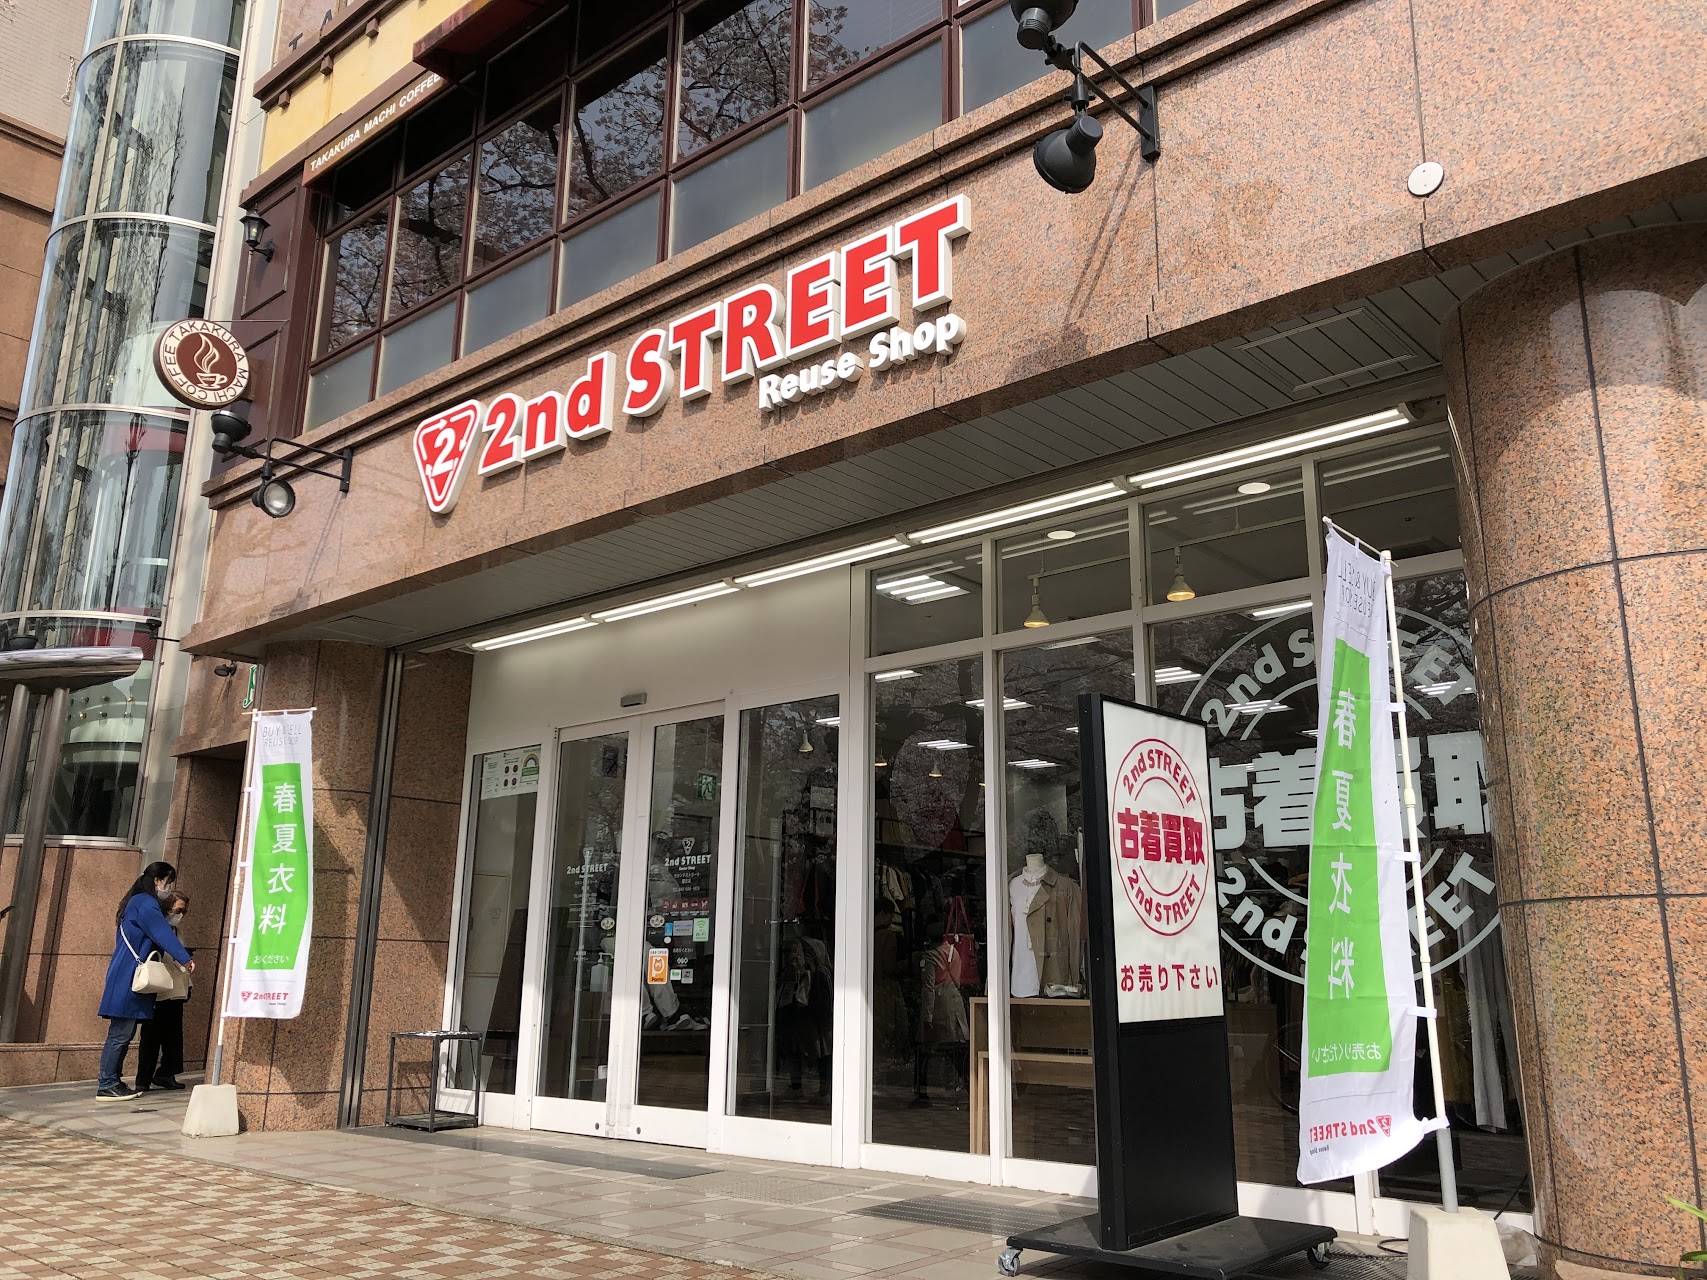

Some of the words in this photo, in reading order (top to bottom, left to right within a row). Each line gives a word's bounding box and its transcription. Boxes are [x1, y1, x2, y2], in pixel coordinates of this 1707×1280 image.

[310, 129, 361, 172] TAKAKURA
[363, 102, 396, 134] MACHI
[398, 73, 441, 109] COFFEE
[168, 321, 246, 363] TAKAKURA
[479, 352, 616, 477] 2nd
[623, 195, 970, 416] STREET
[758, 350, 863, 412] Reuse
[868, 313, 966, 372] Shop
[164, 343, 208, 400] COFFEE
[213, 367, 249, 402] MACHI
[1201, 643, 1287, 738] 2nd
[1122, 755, 1146, 796] 2nd
[1147, 748, 1197, 804] STREET
[1210, 730, 1490, 850] 古着取
[259, 782, 298, 936] 春夏衣料
[664, 856, 680, 867] 2nd
[681, 854, 712, 866] STREET
[1117, 807, 1206, 866] 古着買取
[566, 865, 580, 875] 2nd
[1126, 868, 1153, 918] 2nd
[1154, 873, 1201, 926] STREET
[1217, 868, 1298, 954] 2nd
[1120, 963, 1219, 993] お売り下さい
